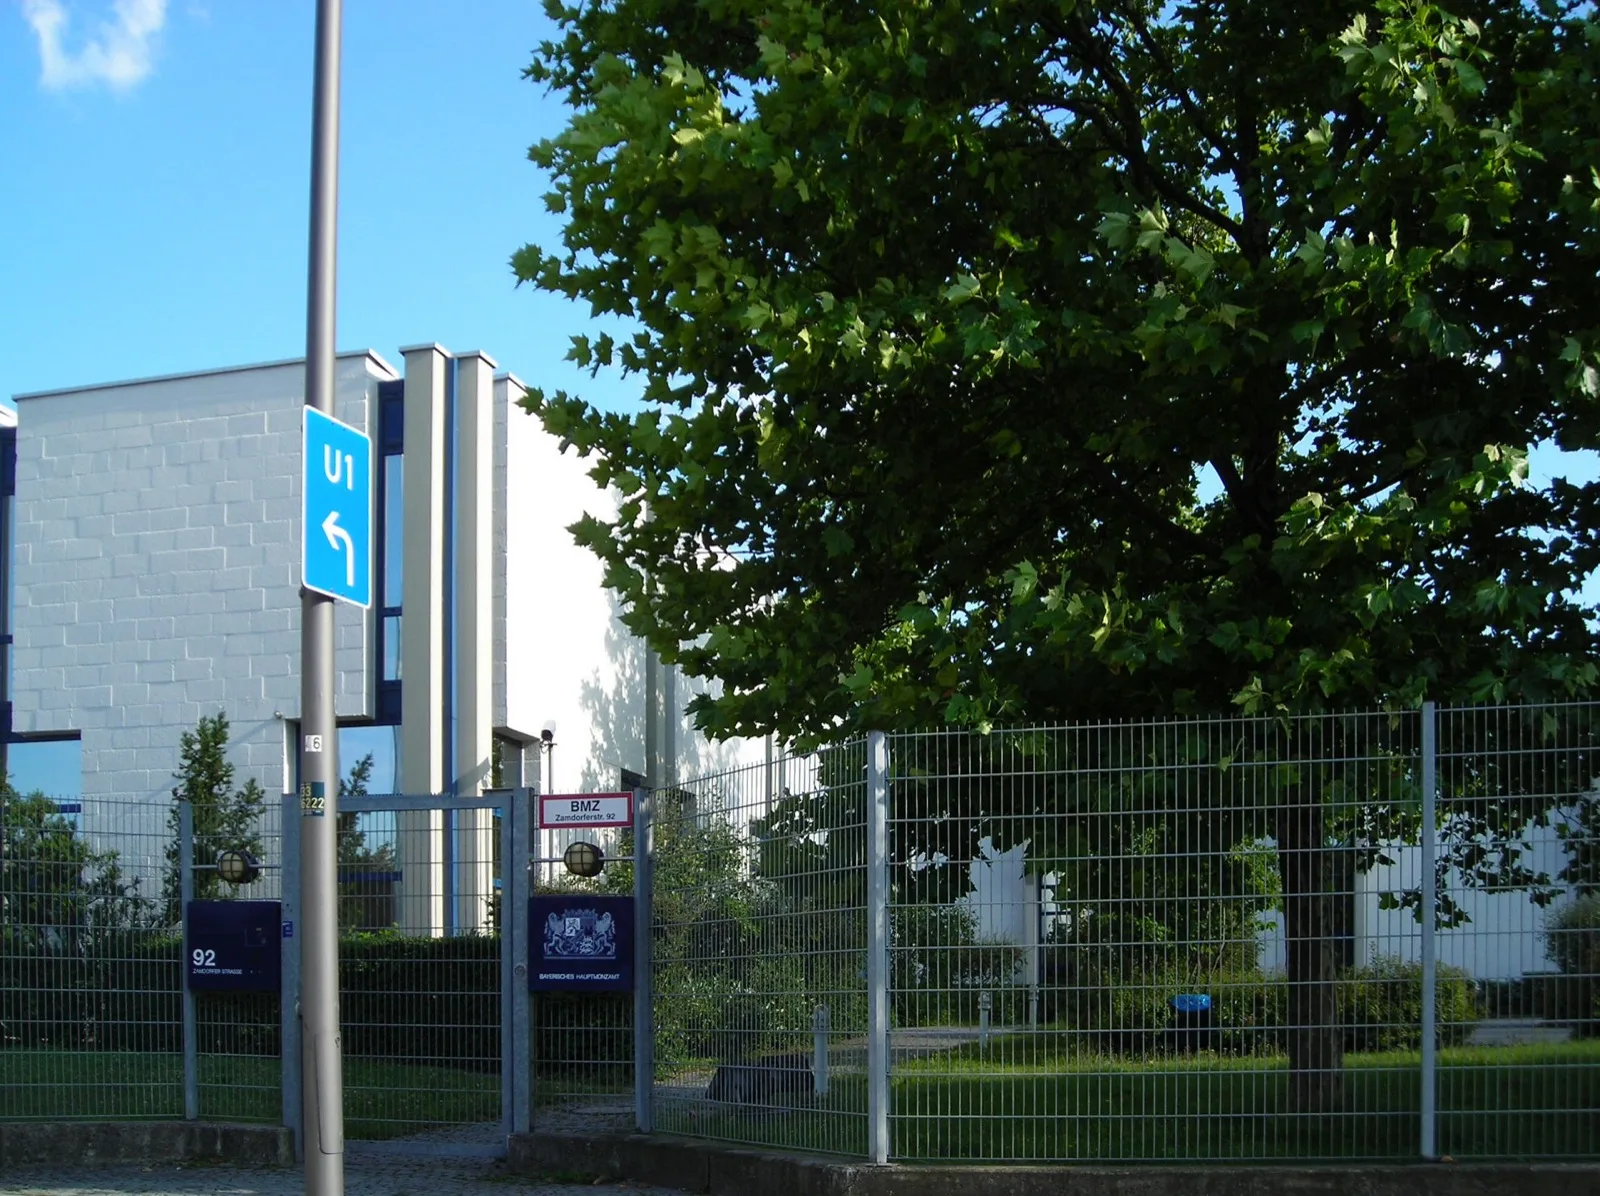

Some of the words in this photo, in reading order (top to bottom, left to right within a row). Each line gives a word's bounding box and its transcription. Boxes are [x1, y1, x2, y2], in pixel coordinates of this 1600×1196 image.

[323, 443, 354, 490] U1
[570, 800, 601, 812] BMZ
[555, 813, 605, 822] Zamdorferstr.
[606, 812, 616, 820] 92
[192, 948, 216, 966] 92
